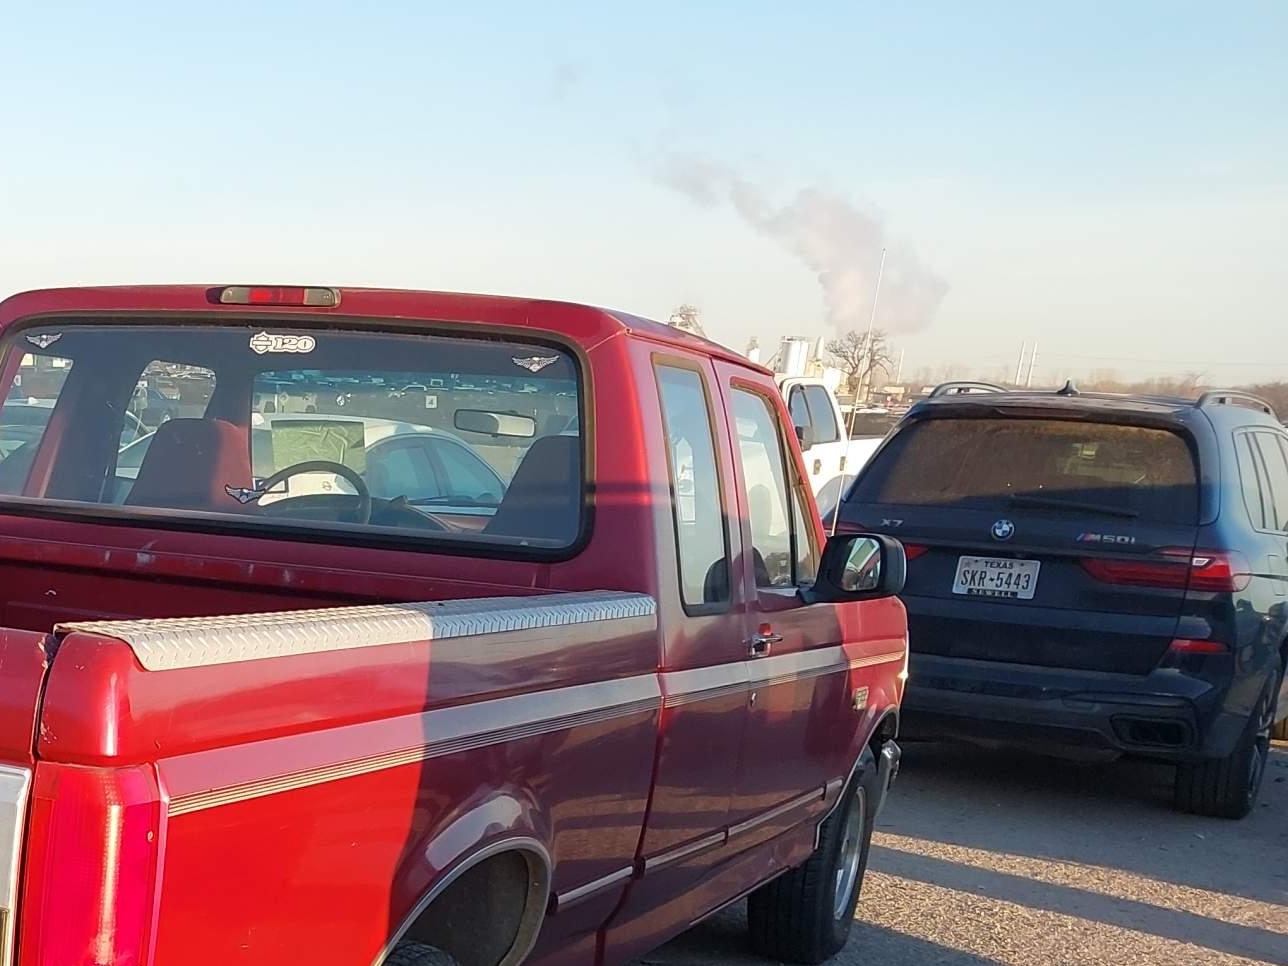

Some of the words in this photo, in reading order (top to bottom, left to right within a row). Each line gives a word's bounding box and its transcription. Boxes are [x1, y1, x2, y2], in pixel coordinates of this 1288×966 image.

[272, 336, 315, 351] 120
[880, 519, 903, 527] X7
[984, 561, 1013, 569] TEXAS
[971, 588, 1013, 598] SEWELL
